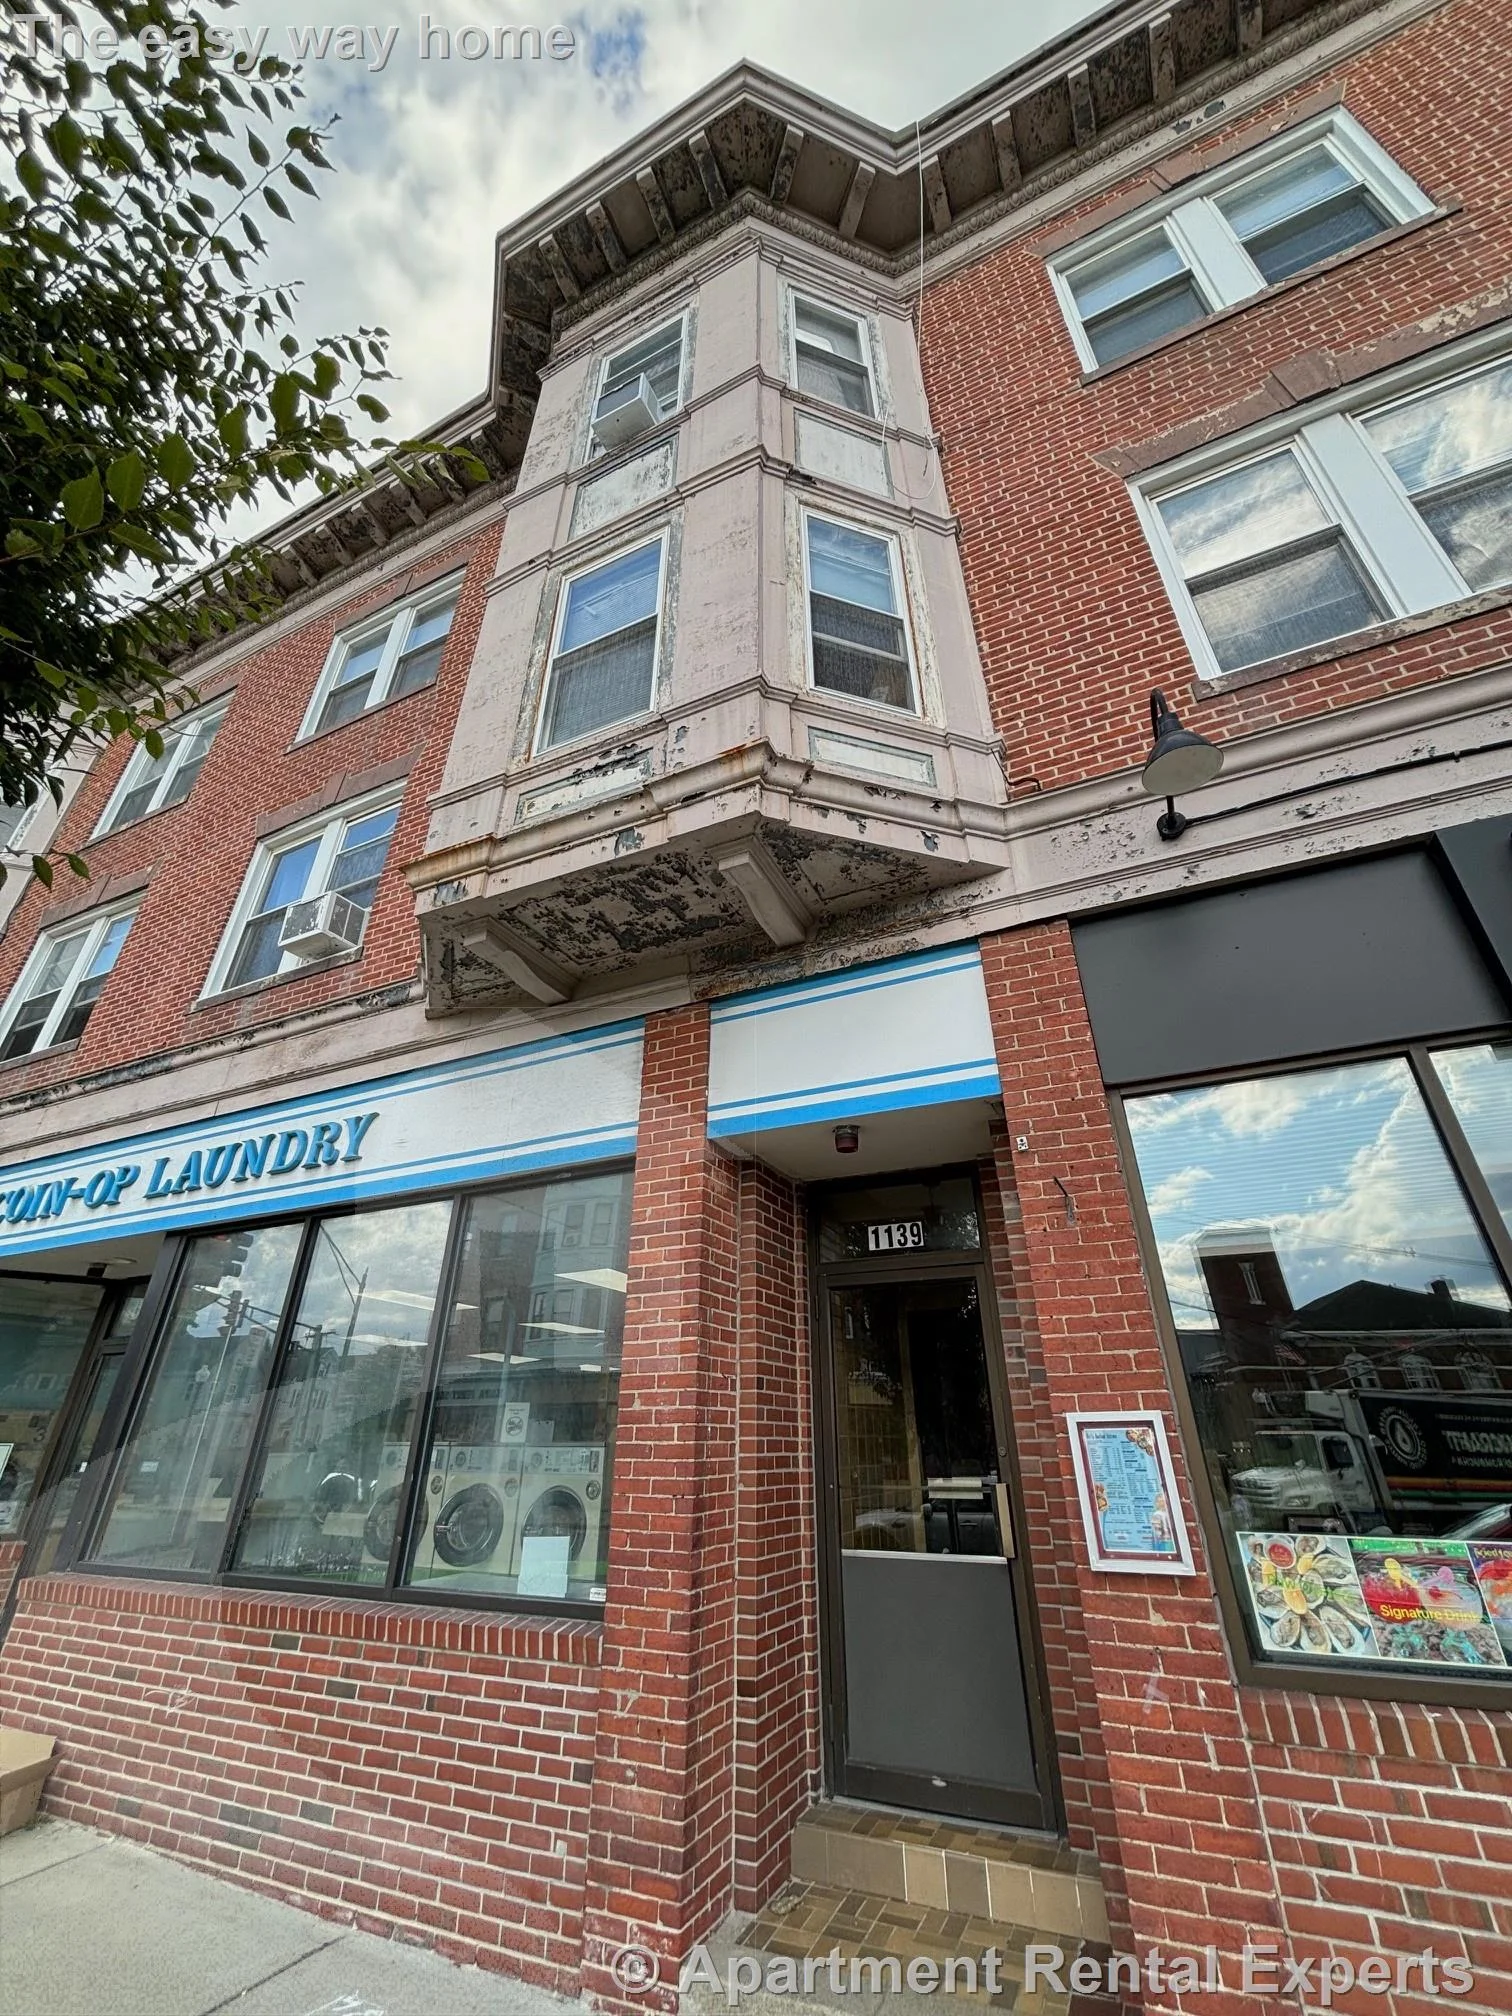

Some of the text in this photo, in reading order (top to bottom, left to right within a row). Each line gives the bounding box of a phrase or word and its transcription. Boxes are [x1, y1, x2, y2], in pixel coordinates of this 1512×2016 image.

[143, 1111, 381, 1200] LAUNDRY
[871, 1222, 922, 1249] 1139
[1380, 1604, 1442, 1620] Signature
